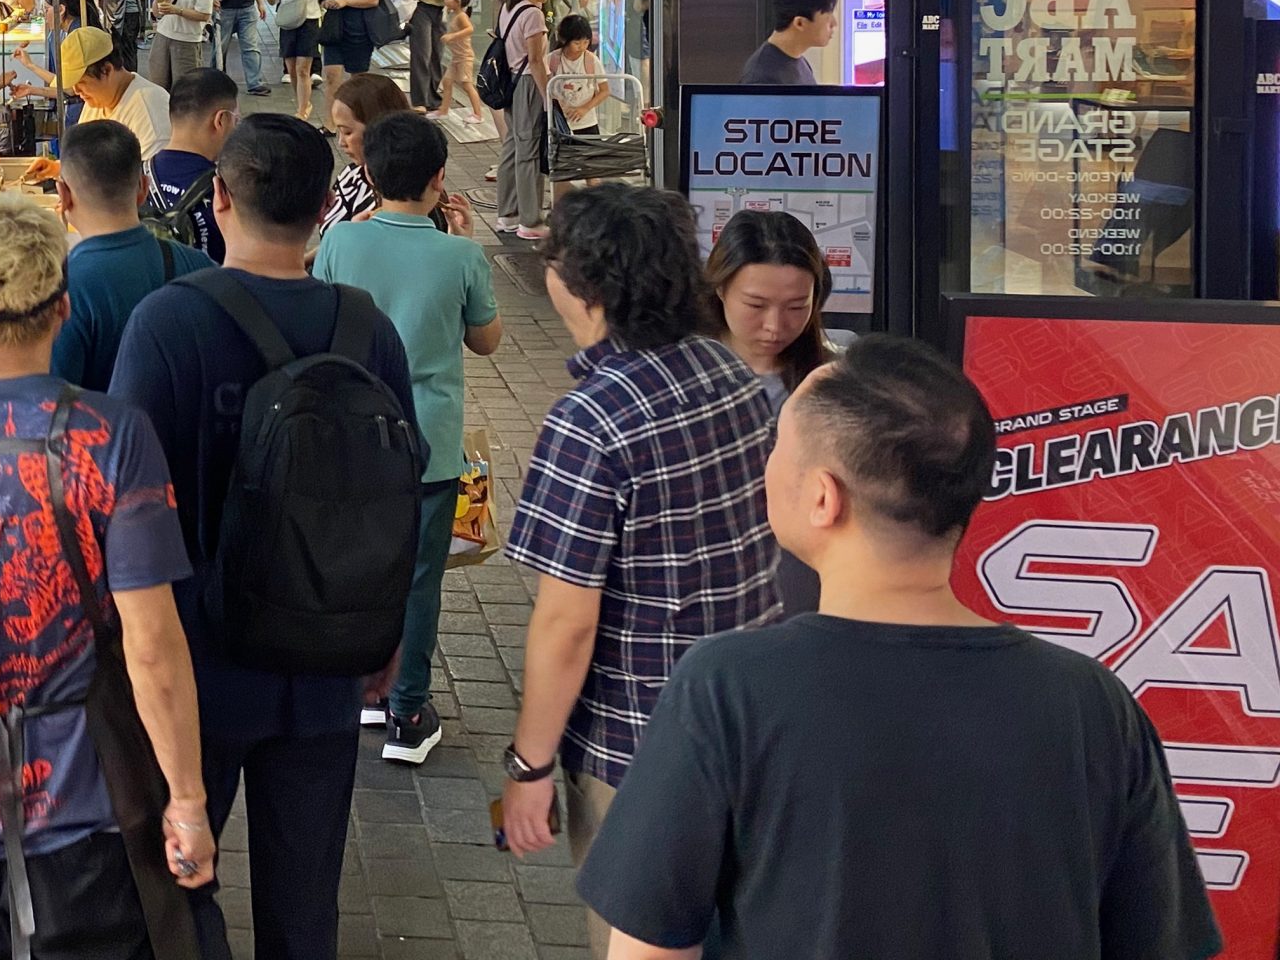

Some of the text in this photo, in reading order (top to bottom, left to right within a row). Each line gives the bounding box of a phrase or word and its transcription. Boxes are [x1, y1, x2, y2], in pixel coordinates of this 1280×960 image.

[922, 15, 940, 24] ABC
[723, 119, 843, 144] STORE
[693, 151, 872, 178] LOCATION
[1057, 397, 1120, 423] STAGE
[982, 396, 1280, 502] CLEARANC
